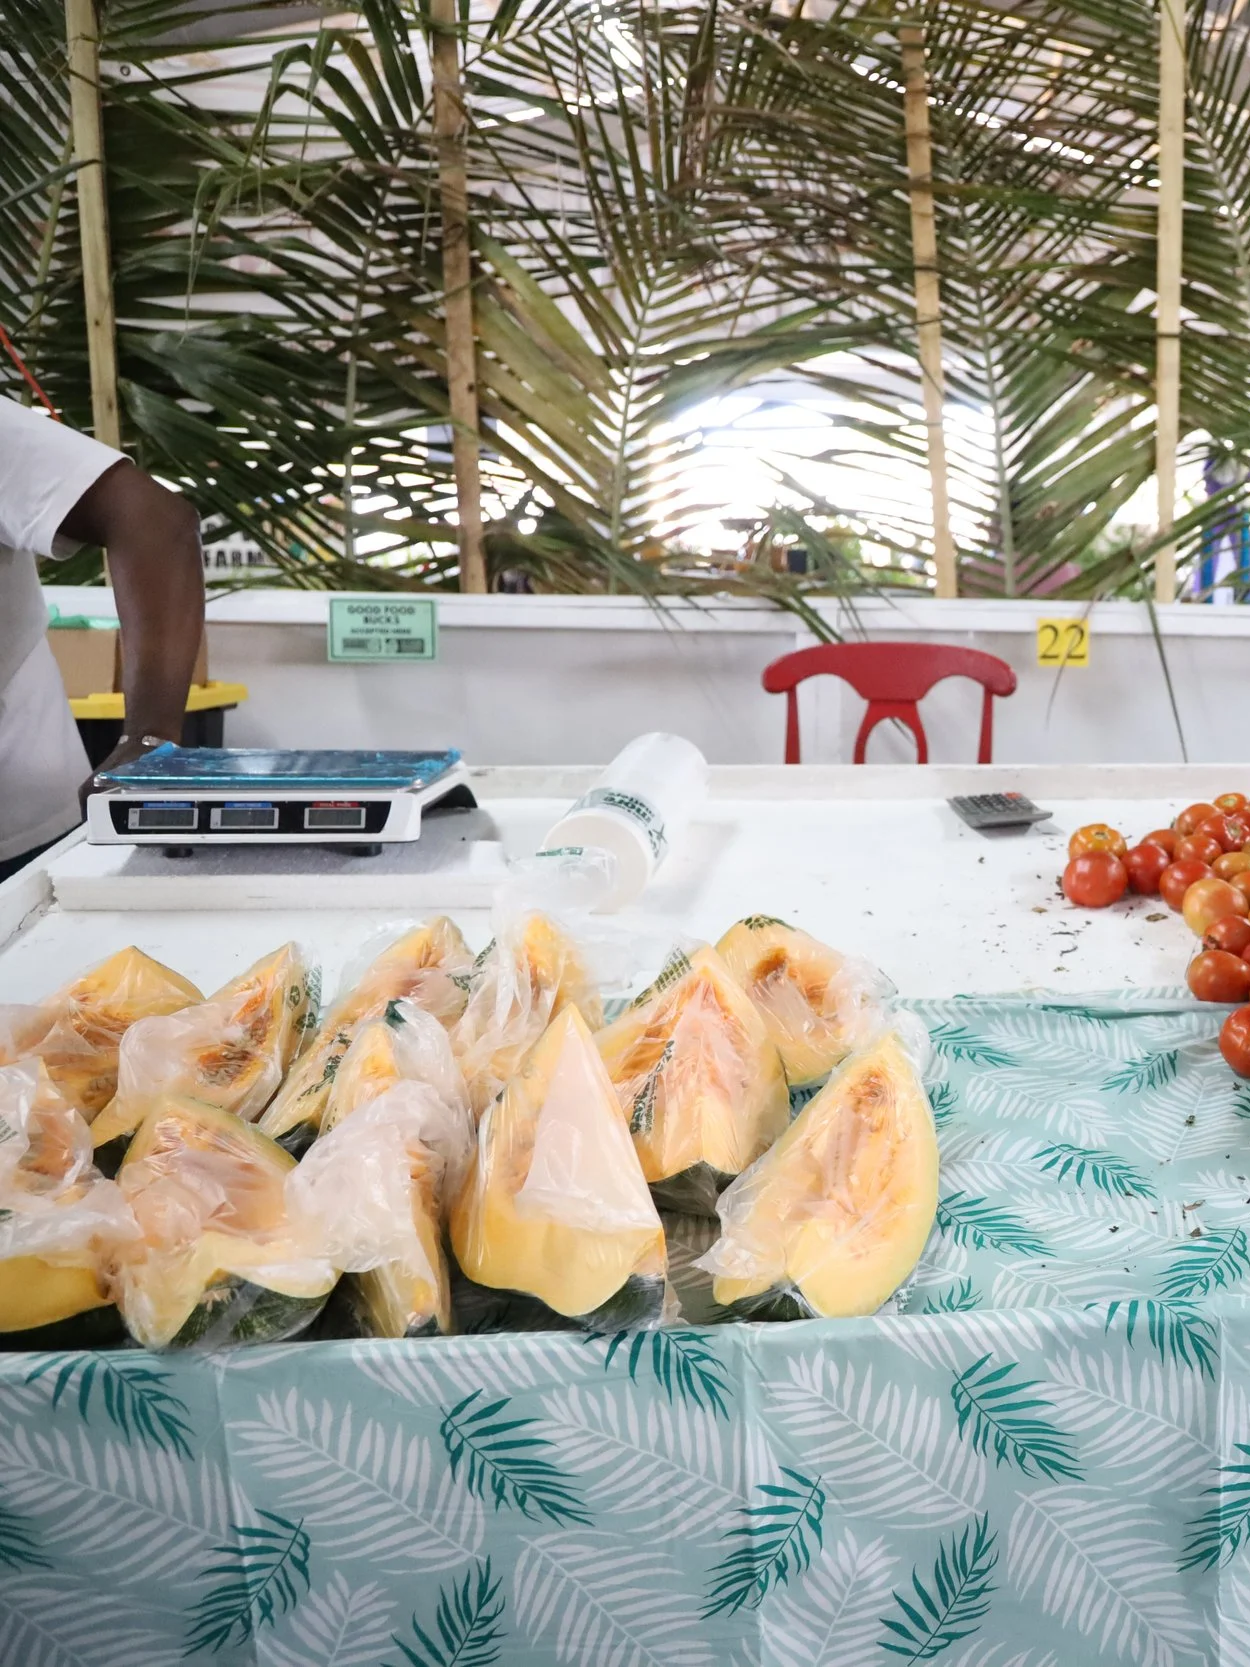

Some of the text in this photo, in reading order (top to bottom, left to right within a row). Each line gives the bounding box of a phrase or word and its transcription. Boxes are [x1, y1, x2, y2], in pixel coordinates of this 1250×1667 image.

[347, 605, 416, 616] GOOD FOOD
[1039, 623, 1085, 661] 22
